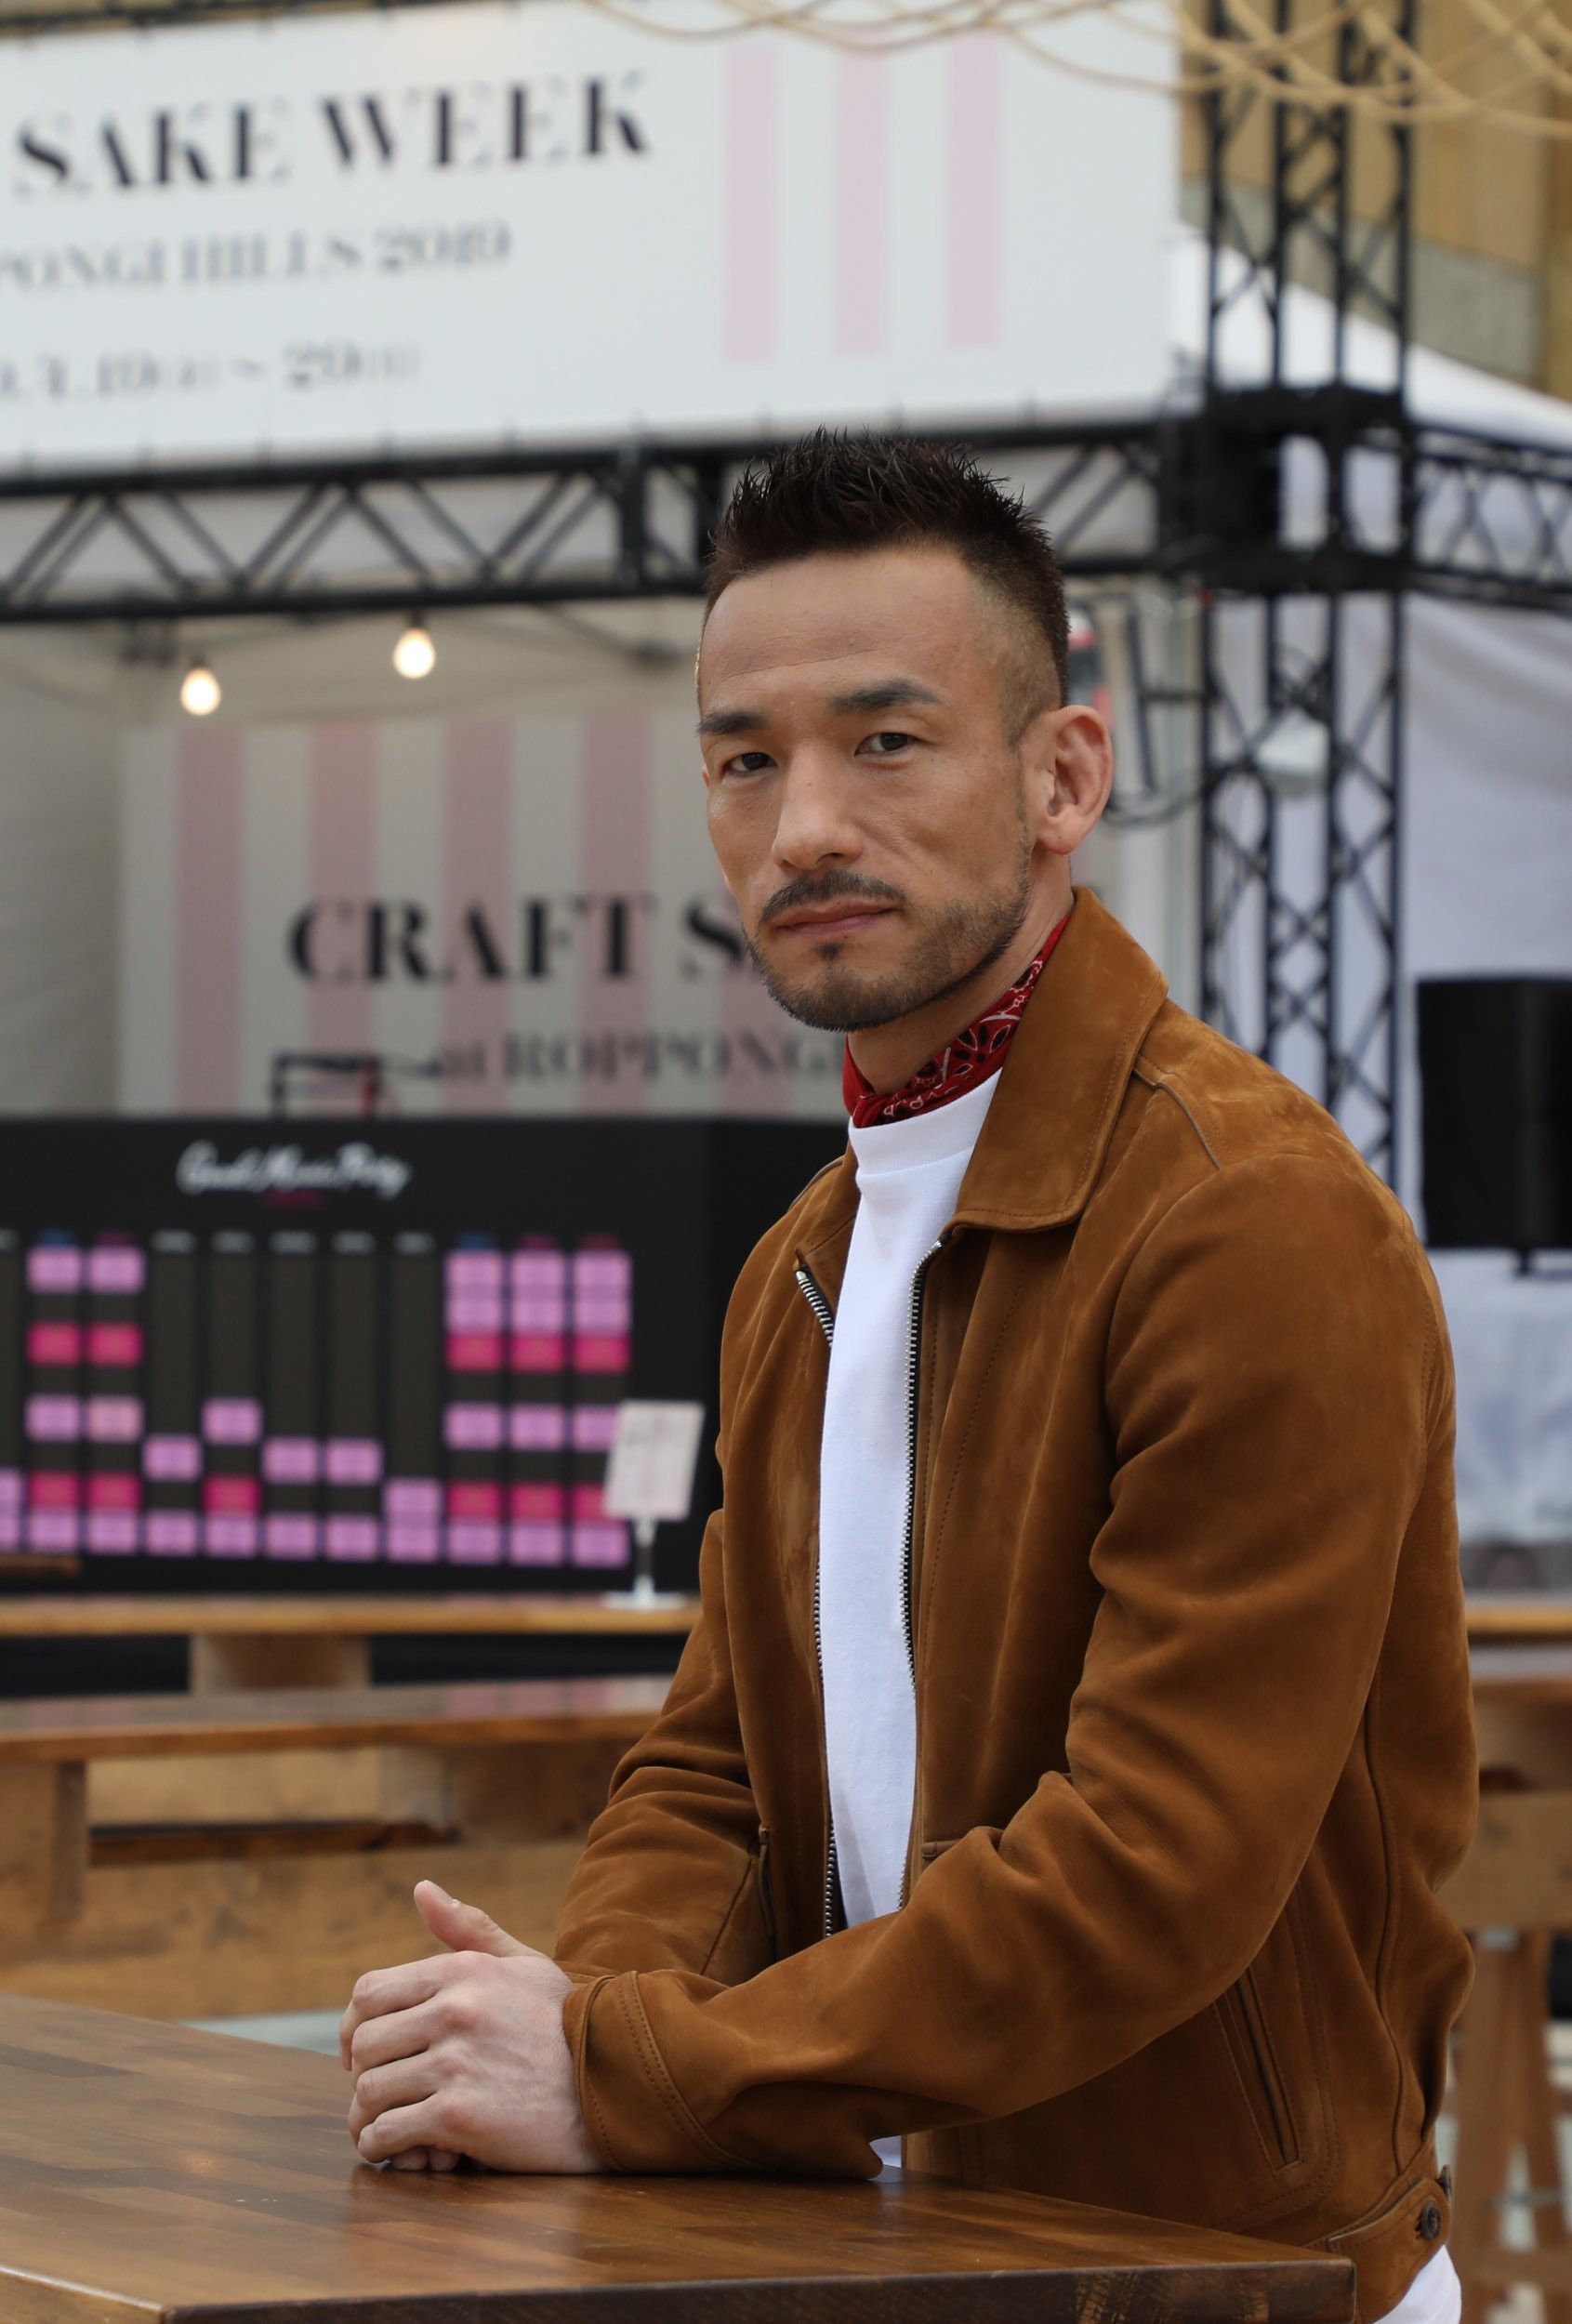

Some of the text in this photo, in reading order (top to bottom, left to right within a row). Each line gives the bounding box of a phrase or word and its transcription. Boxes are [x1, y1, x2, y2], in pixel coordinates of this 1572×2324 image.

[15, 71, 653, 193] SAKE WEEK
[286, 892, 658, 985] CRAFT
